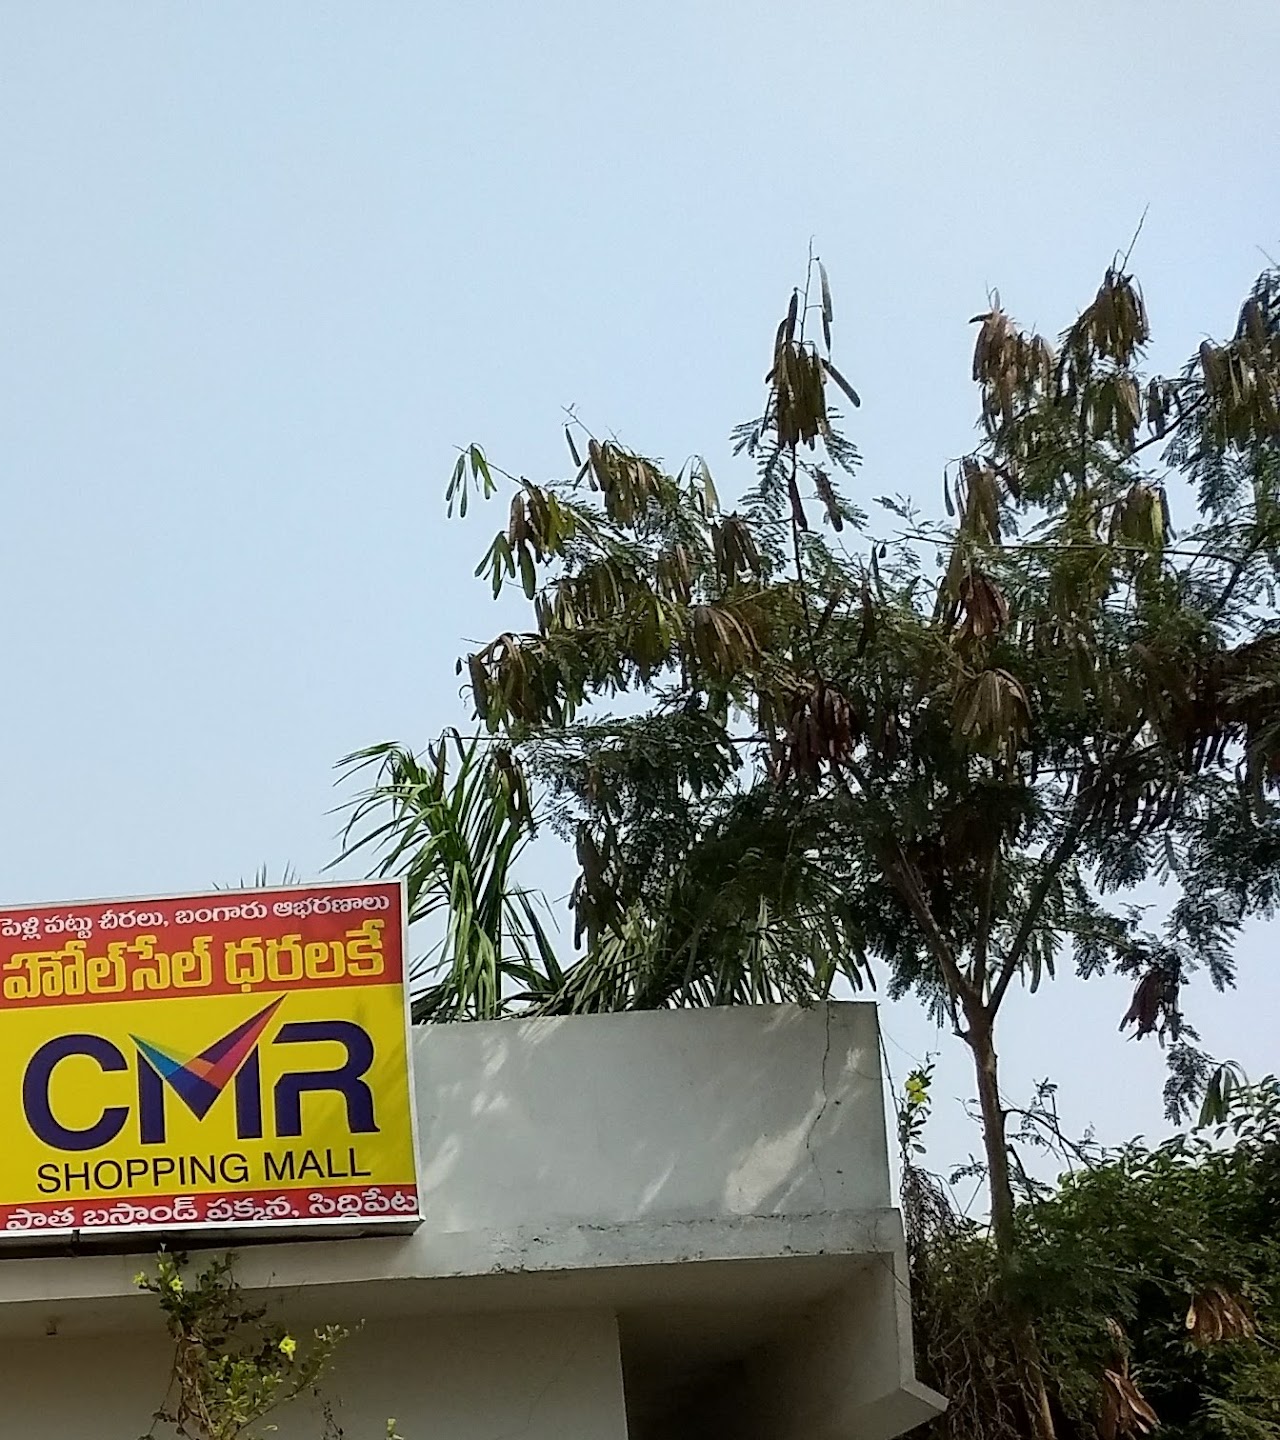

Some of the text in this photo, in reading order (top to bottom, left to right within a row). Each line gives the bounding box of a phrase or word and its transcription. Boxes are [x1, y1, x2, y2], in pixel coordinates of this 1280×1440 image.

[175, 901, 268, 924] బంగారు
[272, 895, 390, 918] ఆభరణాలు
[22, 992, 380, 1152] CMR
[36, 1148, 372, 1194] SHOPPING MALL
